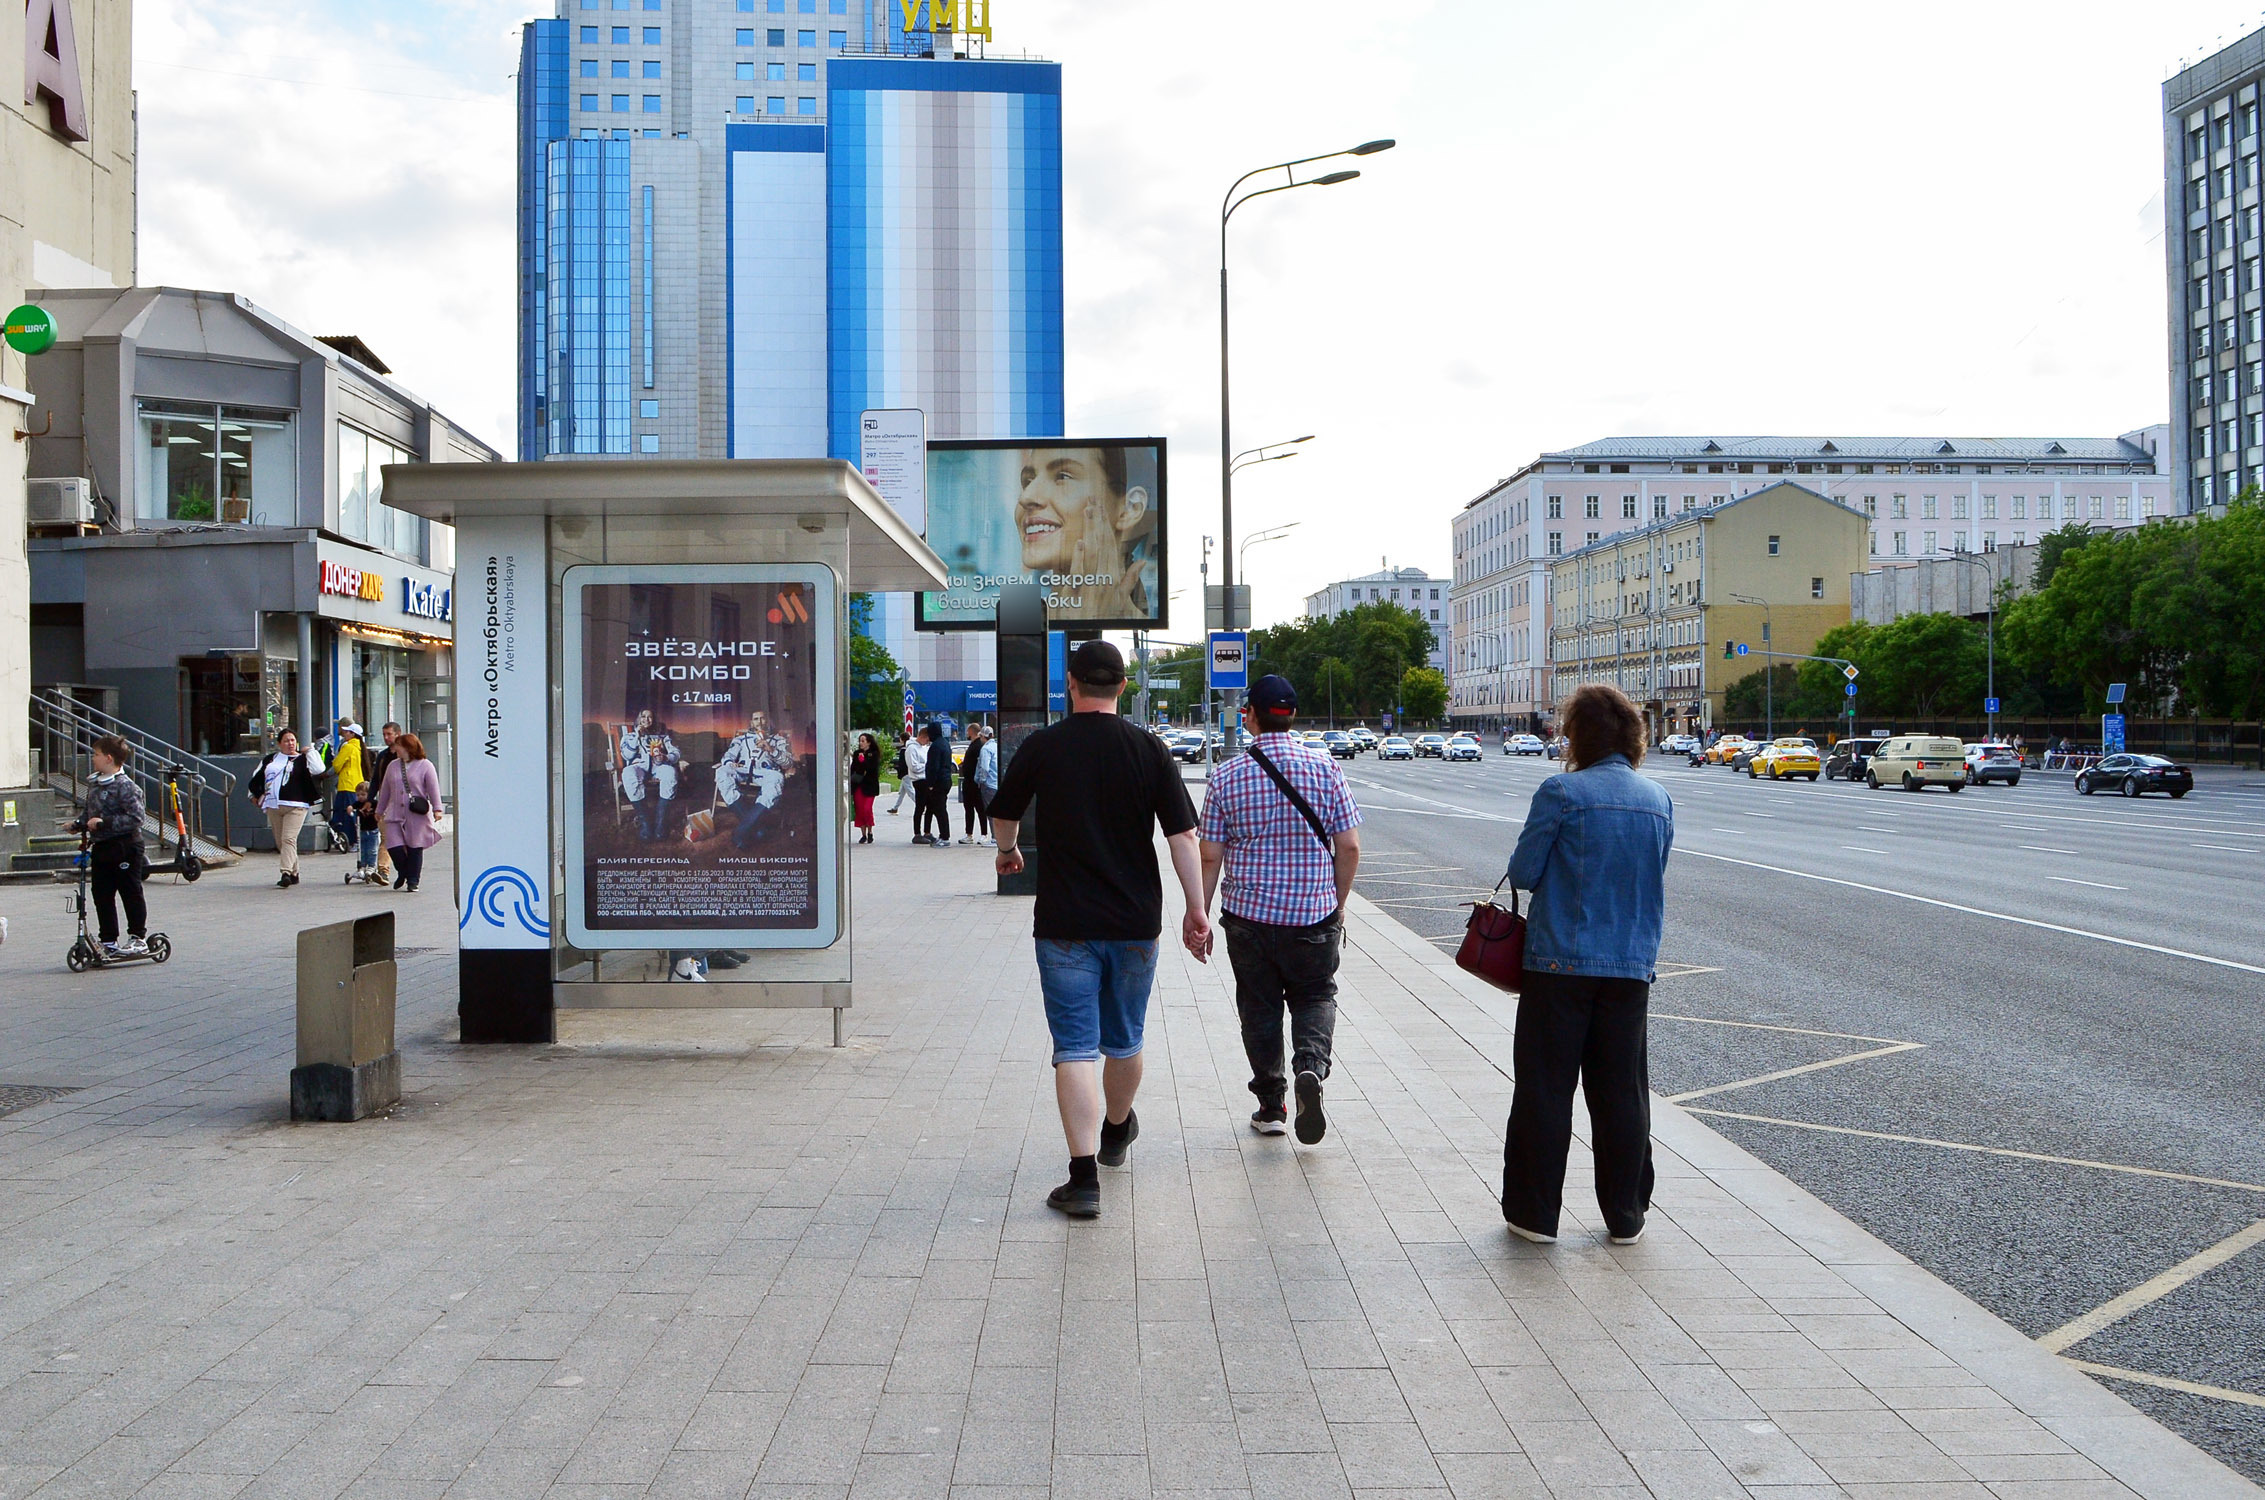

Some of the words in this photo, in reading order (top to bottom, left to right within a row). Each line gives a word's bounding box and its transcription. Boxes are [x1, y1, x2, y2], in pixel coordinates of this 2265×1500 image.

[7, 324, 48, 334] SUBWAY
[323, 561, 361, 596] ДОНЕР
[360, 572, 384, 601] ХАУС
[404, 577, 443, 618] Kafe
[504, 556, 516, 632] Oktyabrskaya
[973, 574, 1033, 591] знаем
[1040, 574, 1112, 588] секрет
[483, 556, 500, 692] «Октябрьская»
[505, 636, 514, 672] Metro
[625, 638, 776, 658] ЗВЁЗДНОЕ
[650, 665, 750, 680] КОМБО
[683, 691, 699, 702] 17
[704, 693, 732, 703] мая
[484, 697, 501, 758] Метро
